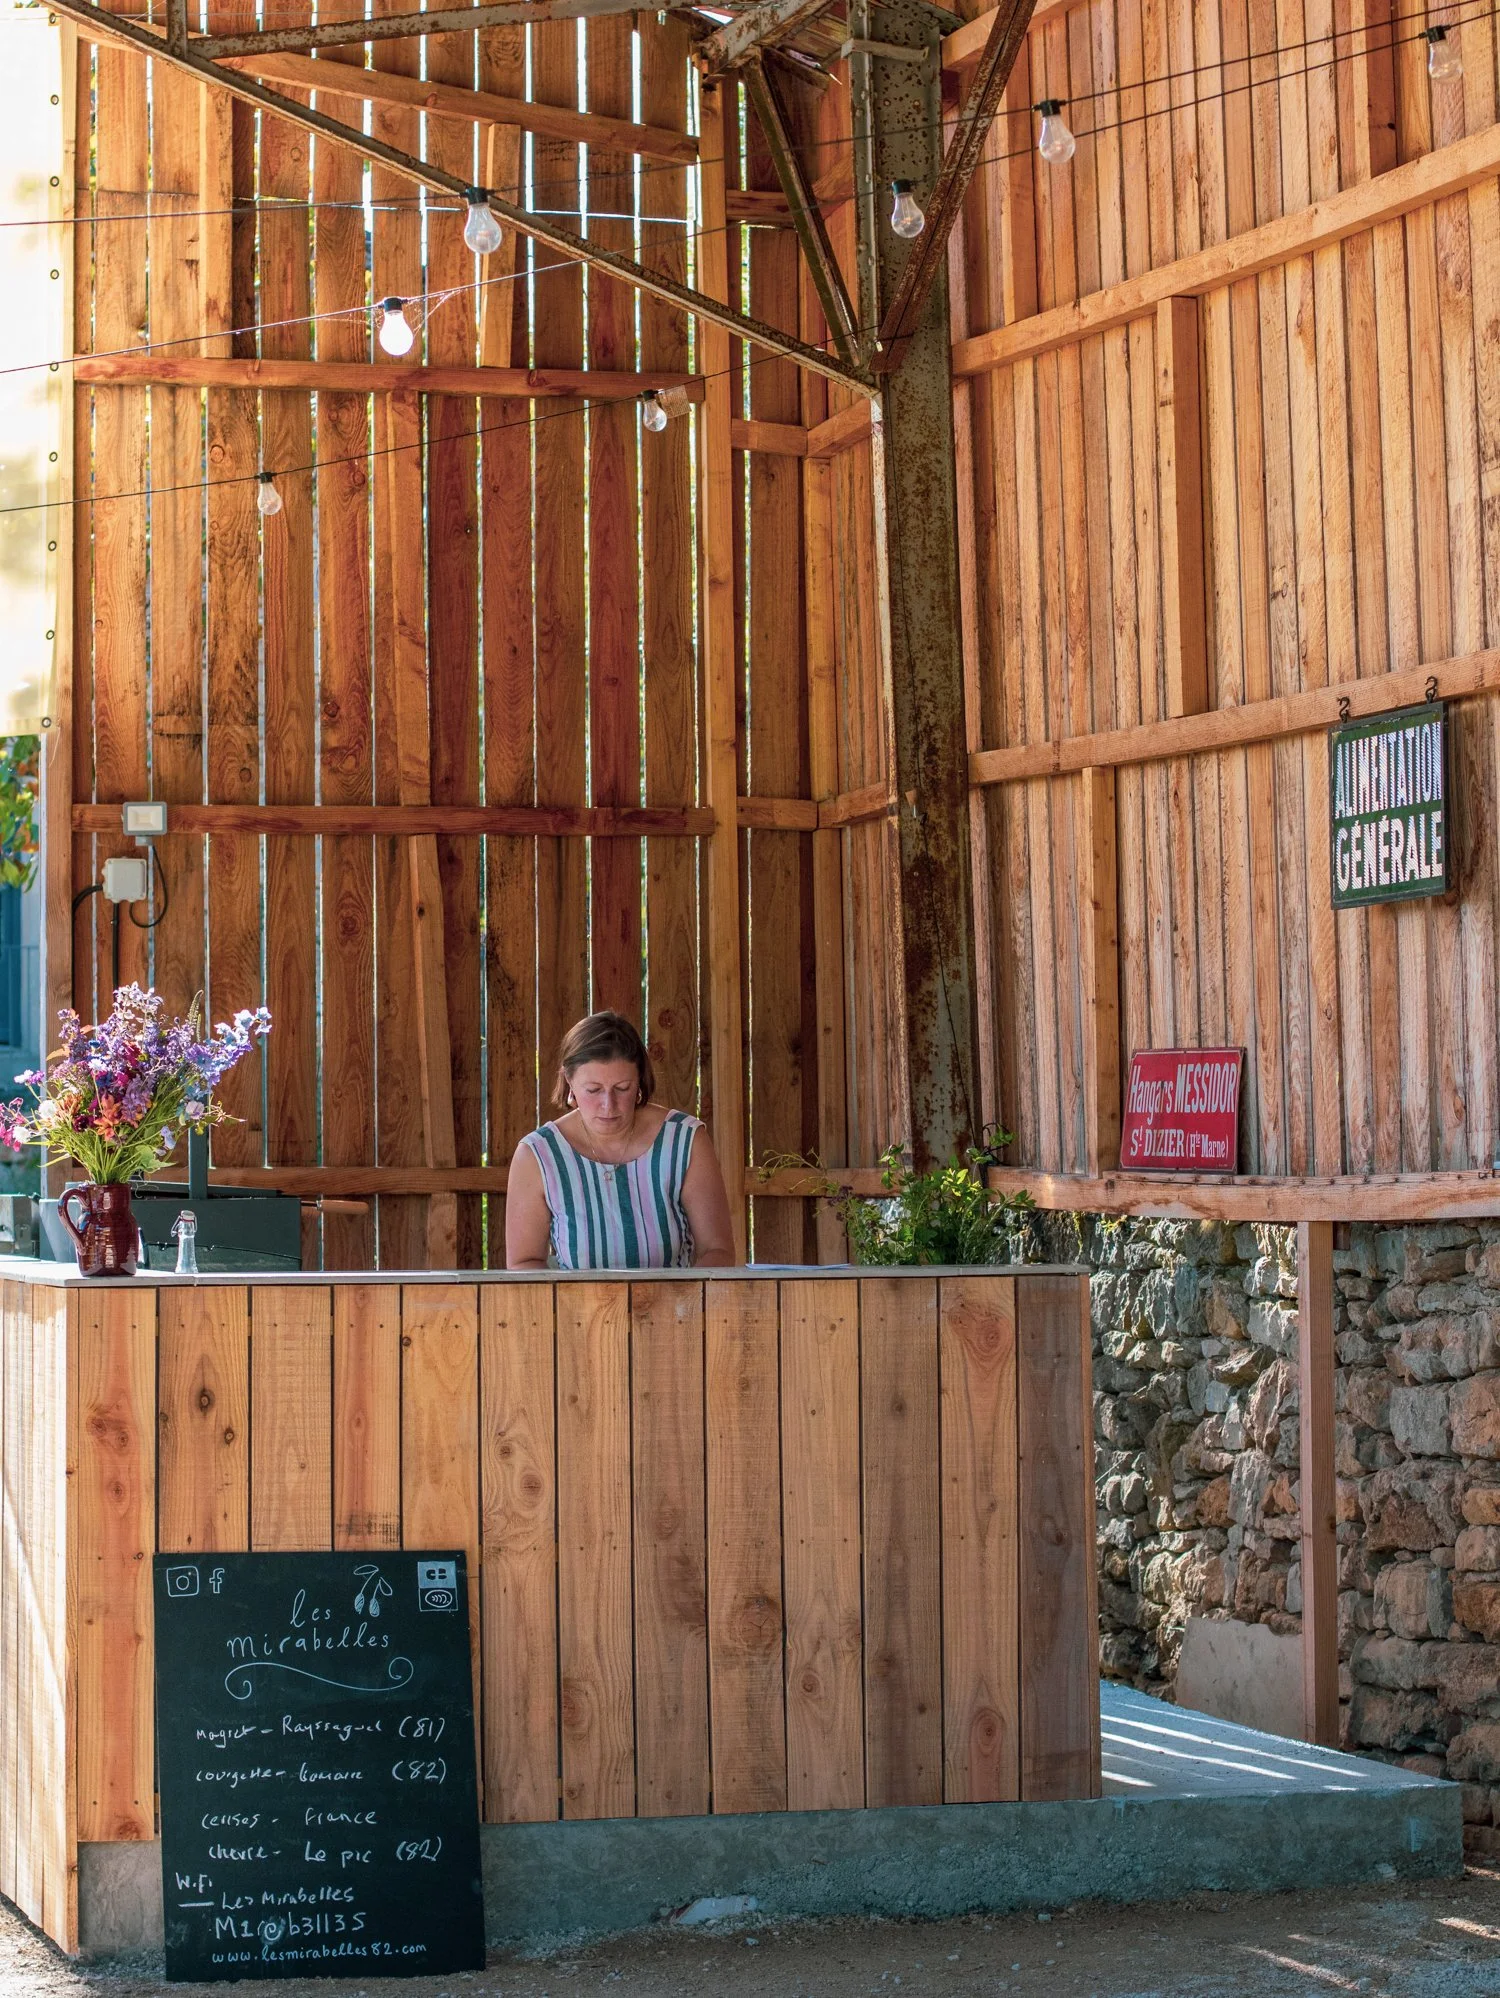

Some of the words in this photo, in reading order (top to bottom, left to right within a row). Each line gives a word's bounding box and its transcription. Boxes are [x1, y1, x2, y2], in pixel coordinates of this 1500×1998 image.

[1335, 721, 1442, 819] ALIMENTATION
[1336, 810, 1443, 892] GÉNÉRALE
[1128, 1065, 1173, 1125] Hangars
[1174, 1063, 1238, 1113] MESSIDOR
[1144, 1129, 1184, 1157] DIZIER
[290, 1589, 331, 1627] les
[227, 1622, 389, 1658] mirabelles
[398, 1716, 446, 1743] (81)
[392, 1757, 447, 1785] (82)
[396, 1836, 442, 1862] (82)
